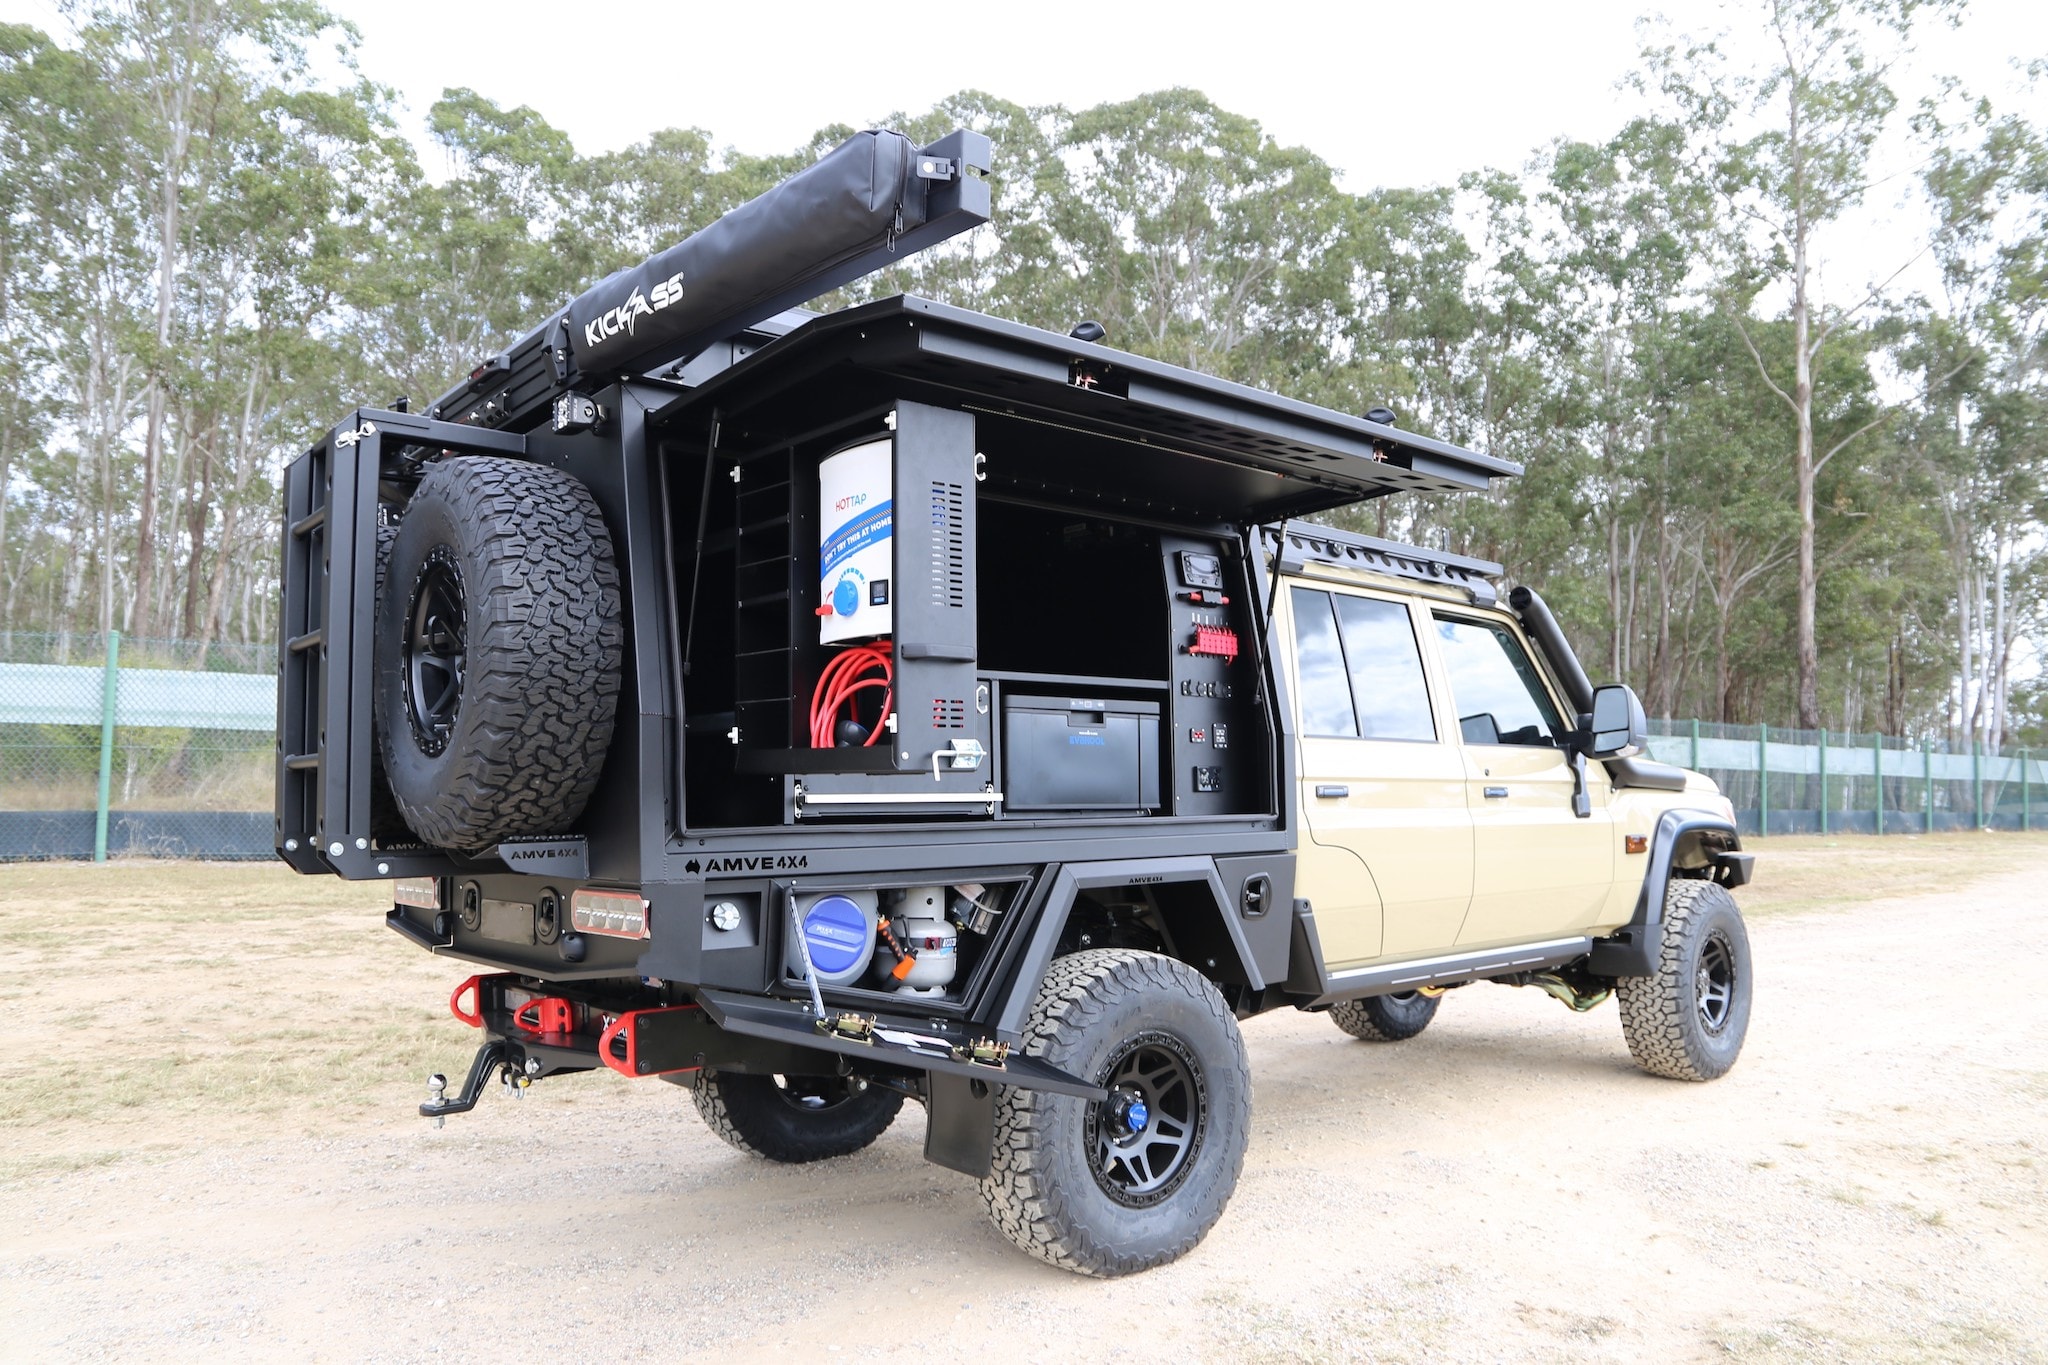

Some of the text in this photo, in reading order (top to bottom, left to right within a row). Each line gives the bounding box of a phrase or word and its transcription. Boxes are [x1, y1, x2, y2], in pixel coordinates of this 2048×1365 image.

[585, 273, 684, 348] KICKASS
[835, 493, 867, 512] HOTTAP
[837, 539, 847, 553] TRY
[847, 531, 860, 545] THIS
[862, 526, 870, 538] AT
